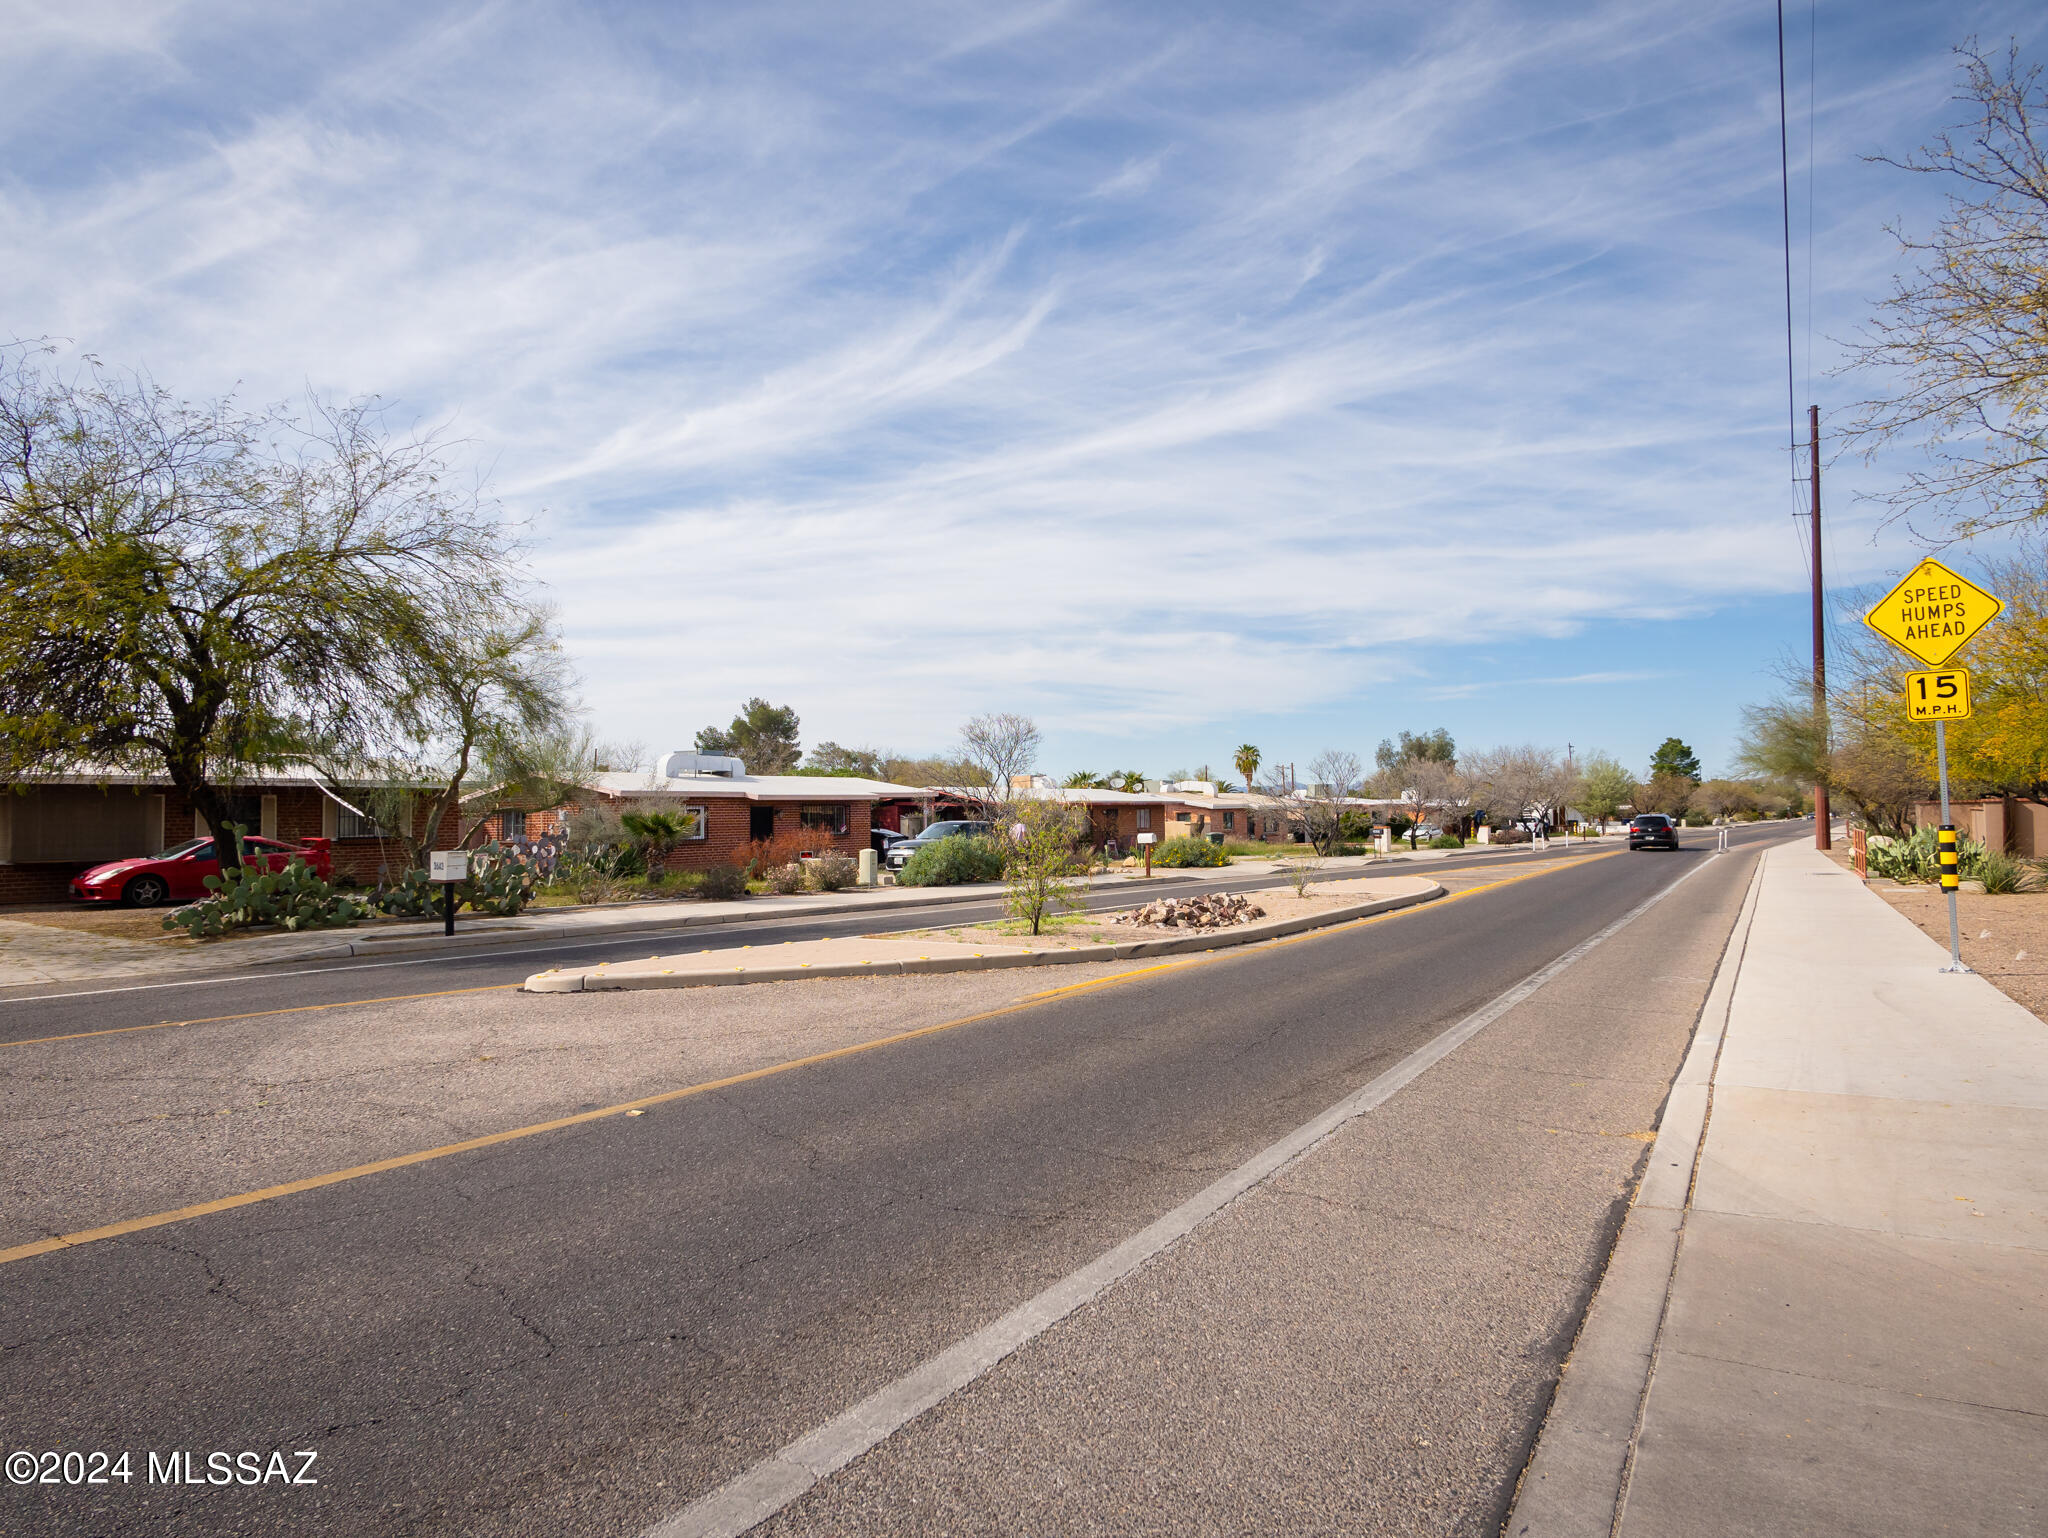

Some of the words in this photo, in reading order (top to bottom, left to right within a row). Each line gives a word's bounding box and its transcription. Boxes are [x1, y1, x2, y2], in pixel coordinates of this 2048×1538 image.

[1904, 585, 1961, 604] SPEED
[1902, 603, 1966, 622] HUMPS
[1905, 621, 1965, 640] AHEAD
[1916, 675, 1958, 700] 15
[1916, 705, 1962, 715] M.P.H.
